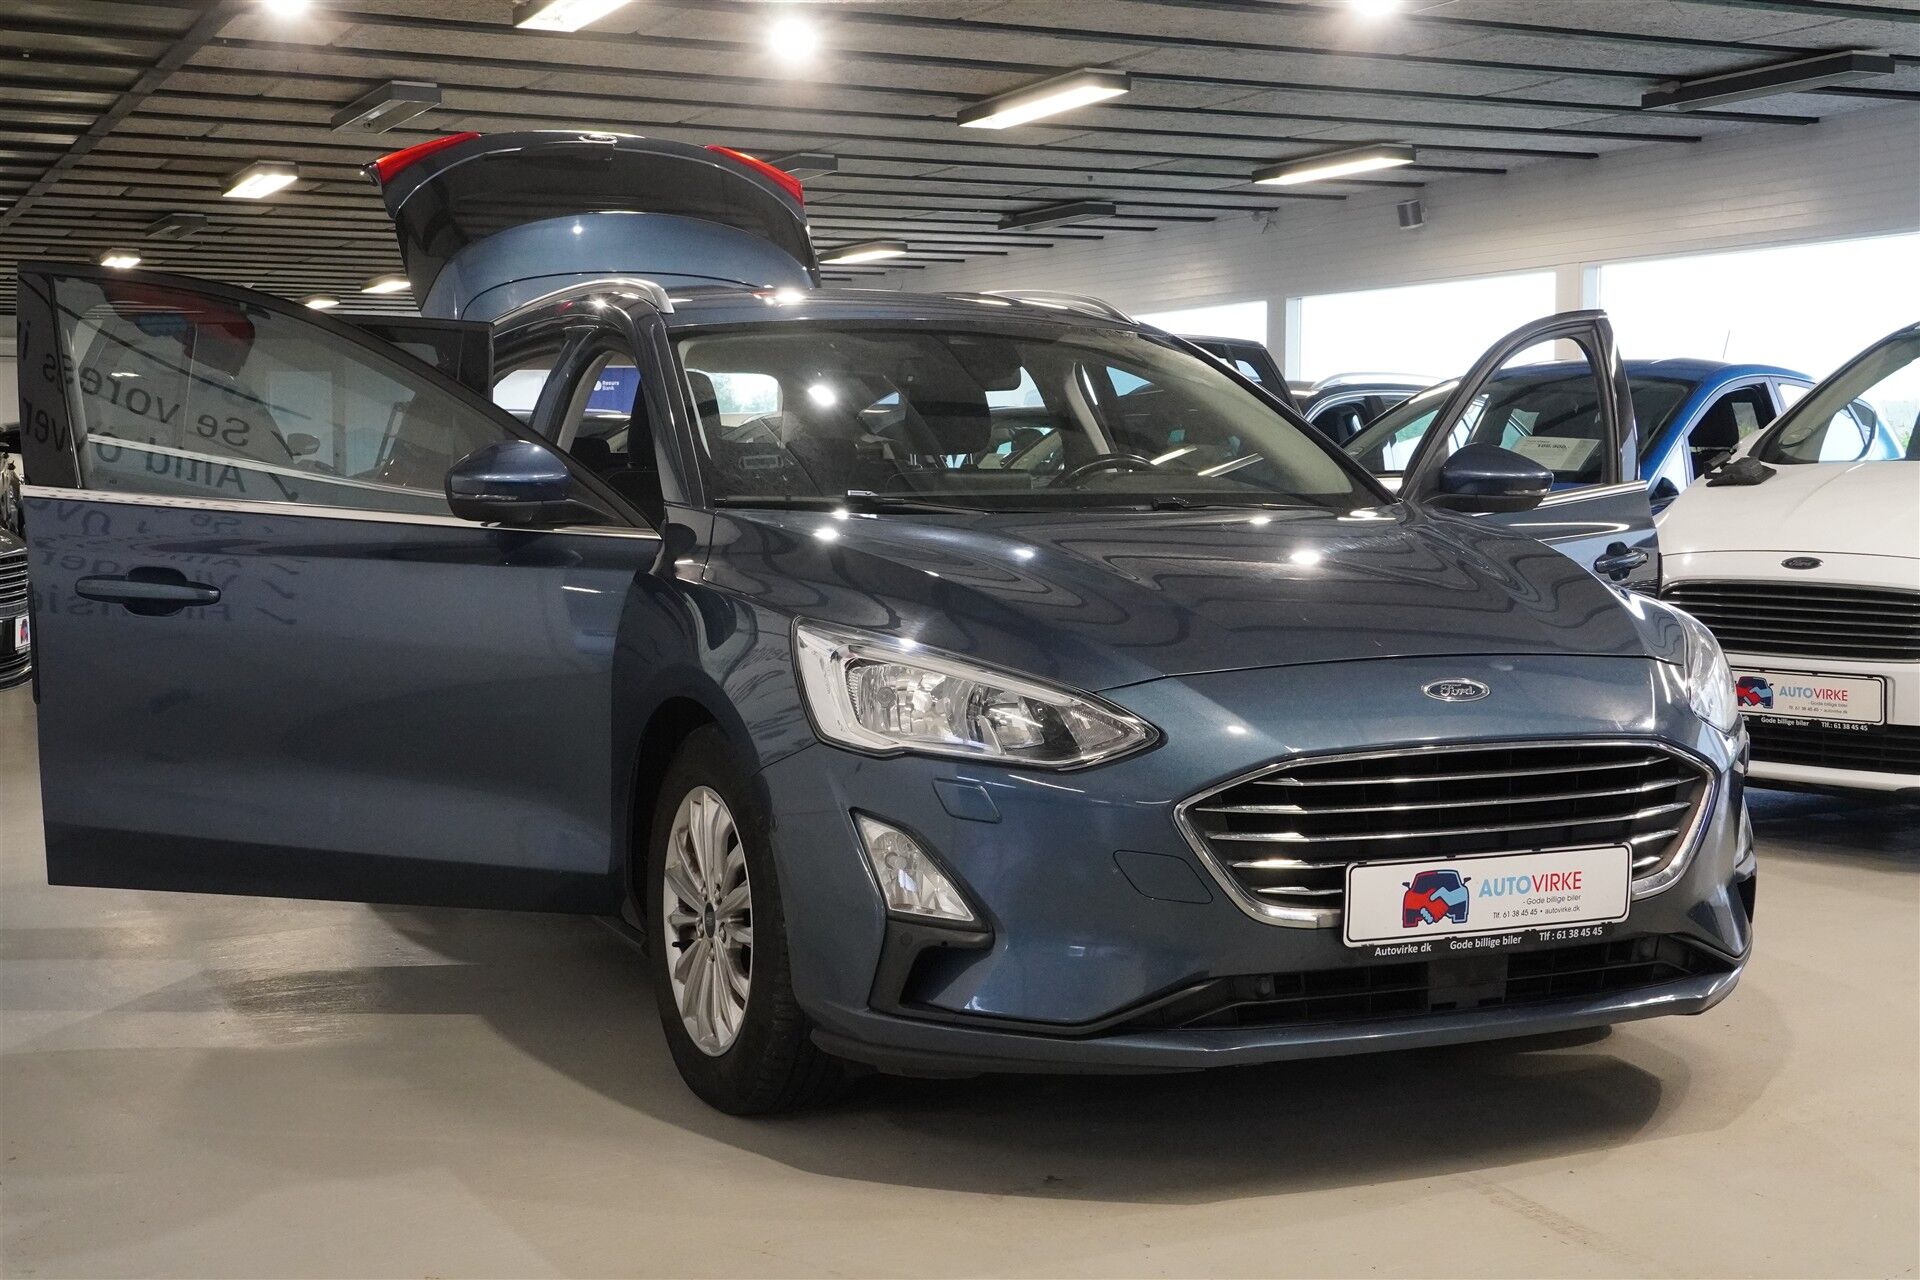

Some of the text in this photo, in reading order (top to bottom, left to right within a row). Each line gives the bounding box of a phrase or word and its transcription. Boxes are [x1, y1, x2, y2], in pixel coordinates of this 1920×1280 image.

[1440, 683, 1476, 696] Ford
[1779, 686, 1848, 701] AUTOVIRKE
[1761, 716, 1776, 724] Gode
[1777, 718, 1795, 726] billige
[1479, 871, 1582, 898] AUTOVIRKE
[1546, 895, 1566, 904] billige
[1567, 894, 1581, 902] biler
[1520, 909, 1529, 917] 45
[1530, 908, 1538, 916] 45
[1545, 905, 1581, 914] autovirke.dk
[1374, 944, 1418, 956] Autovirke
[1420, 943, 1432, 952] dk
[1450, 940, 1473, 950] Gode
[1475, 937, 1501, 948] billige
[1502, 935, 1522, 945] biler
[1556, 930, 1567, 939] 61
[1568, 929, 1579, 938] 38
[1580, 928, 1591, 937] 45
[1592, 926, 1603, 936] 45
